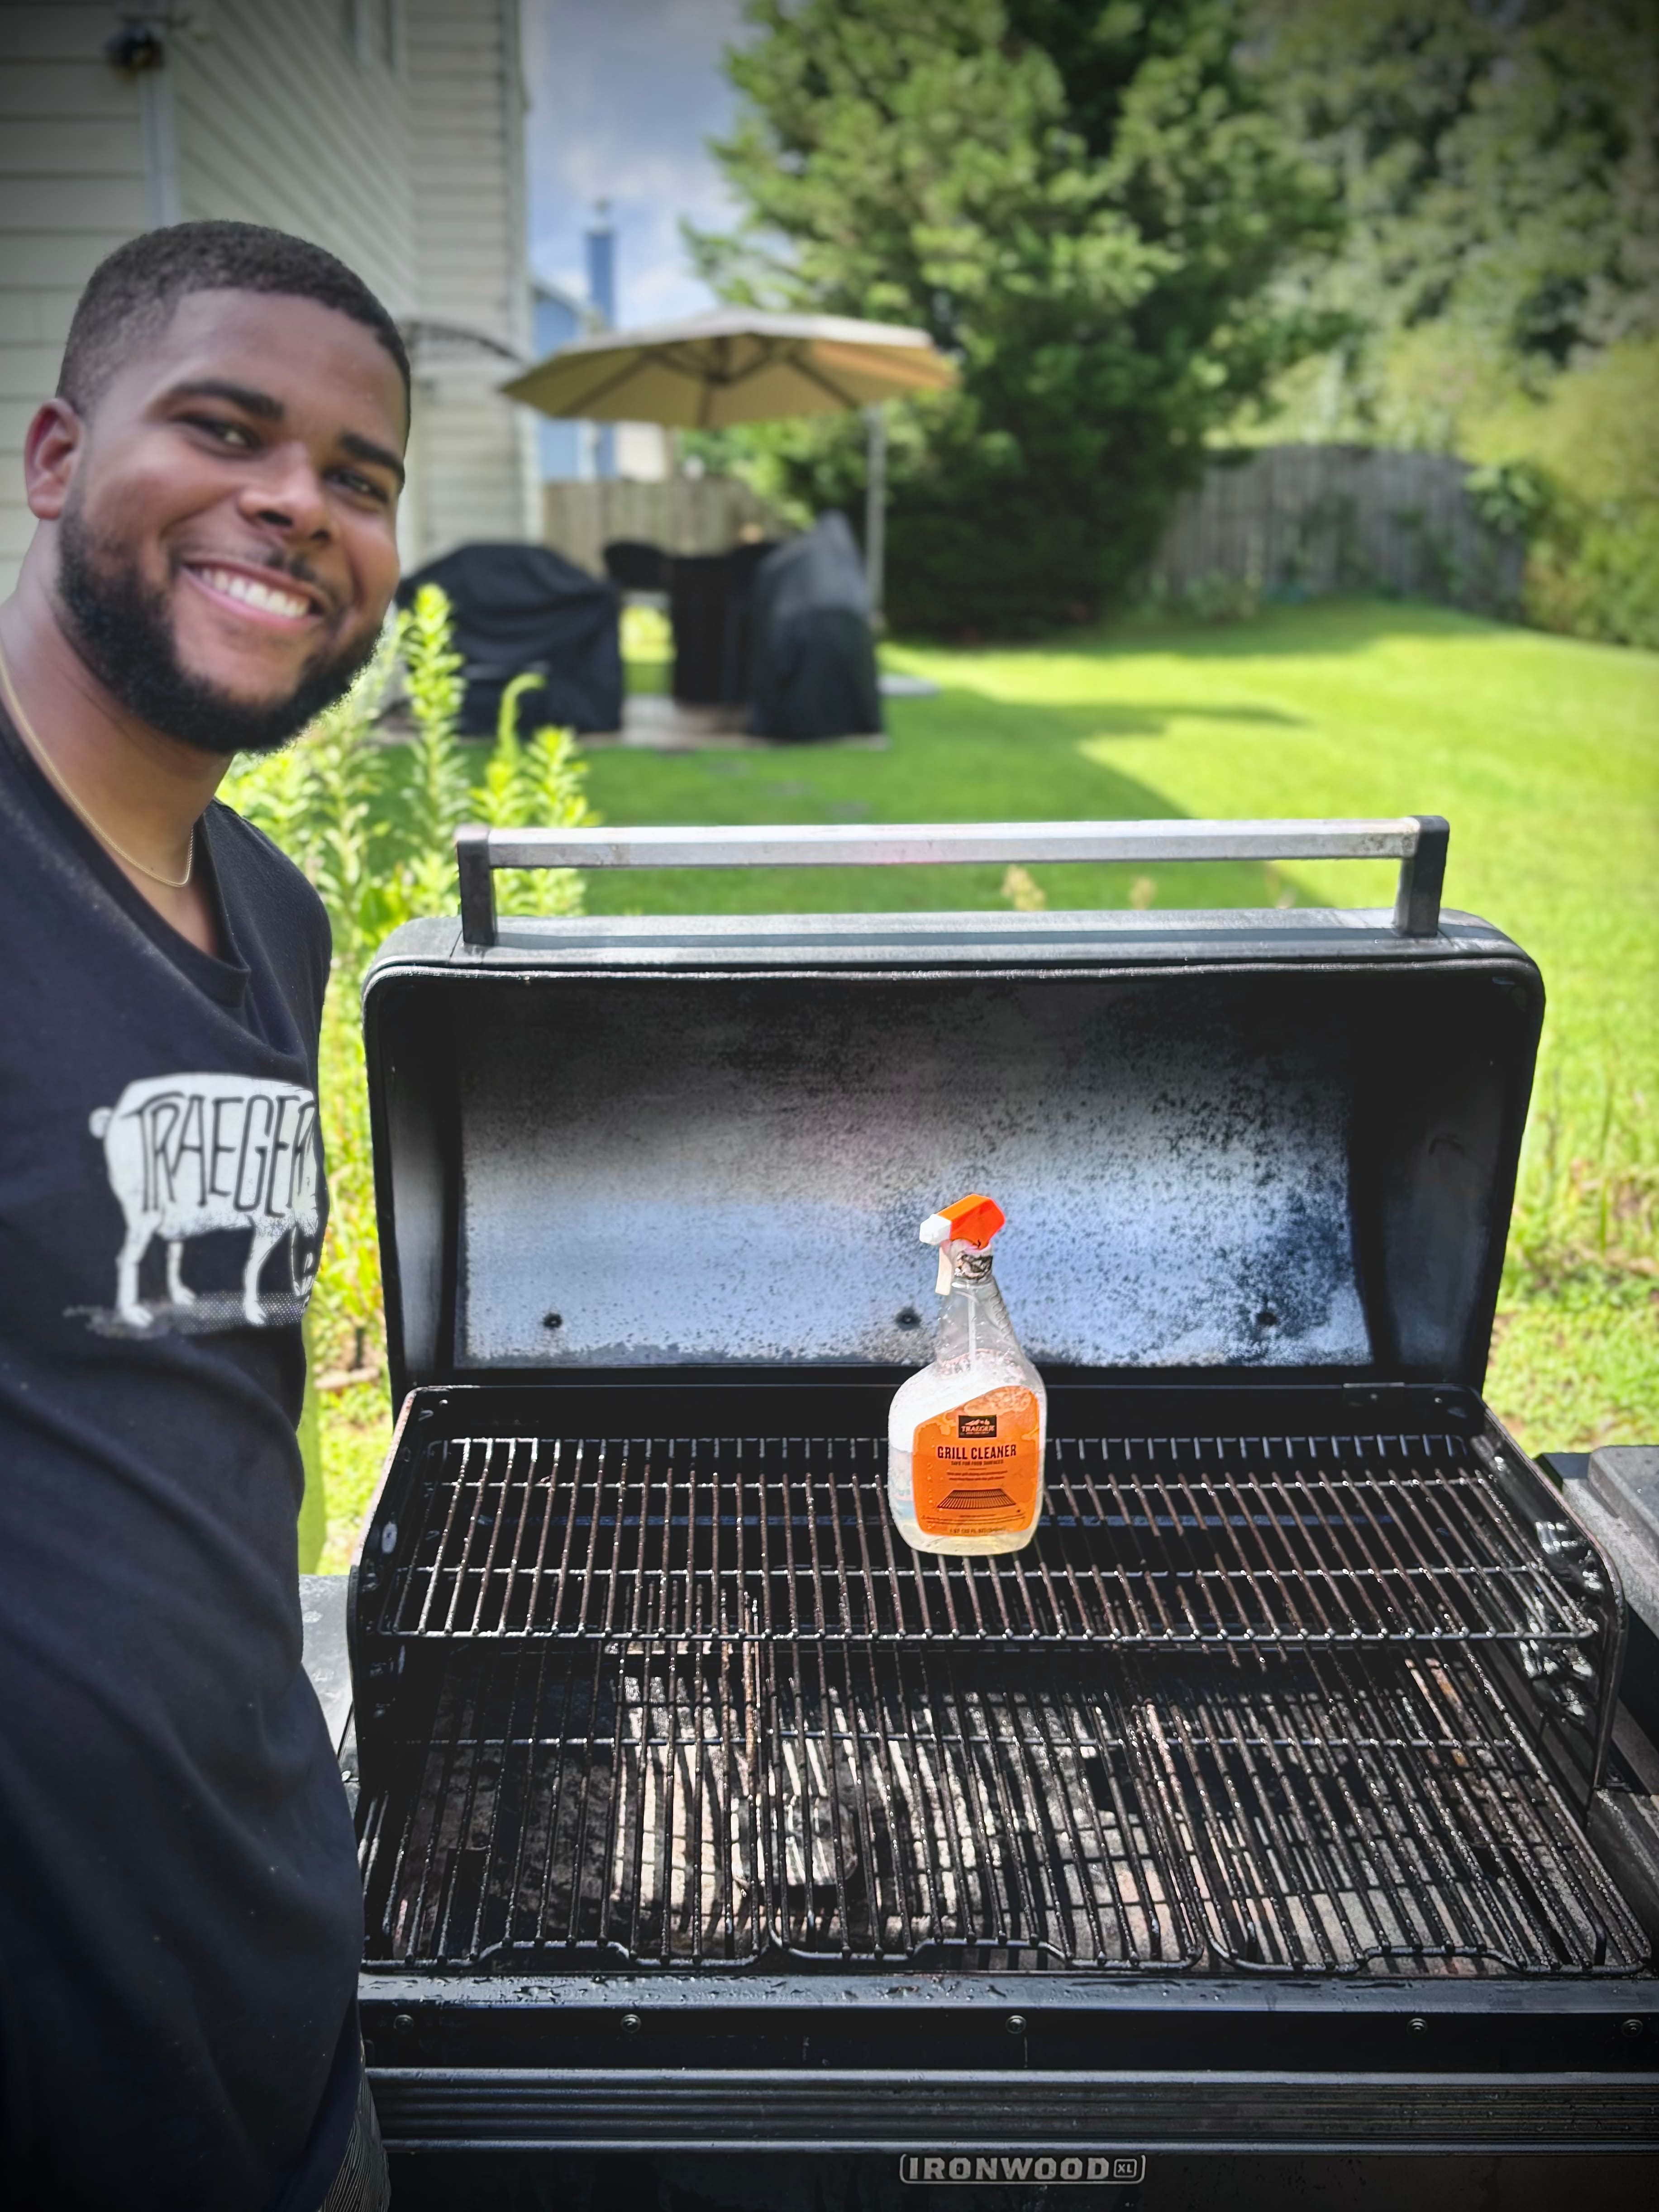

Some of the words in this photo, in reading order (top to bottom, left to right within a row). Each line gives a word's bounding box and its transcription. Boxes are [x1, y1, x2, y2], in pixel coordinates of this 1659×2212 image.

[120, 1091, 316, 1218] TRAEGER
[937, 1446, 968, 1459] GRILL
[971, 1444, 1016, 1460] CLEANER
[909, 2157, 1109, 2180] IRONWOOD
[1117, 2163, 1133, 2173] XL
